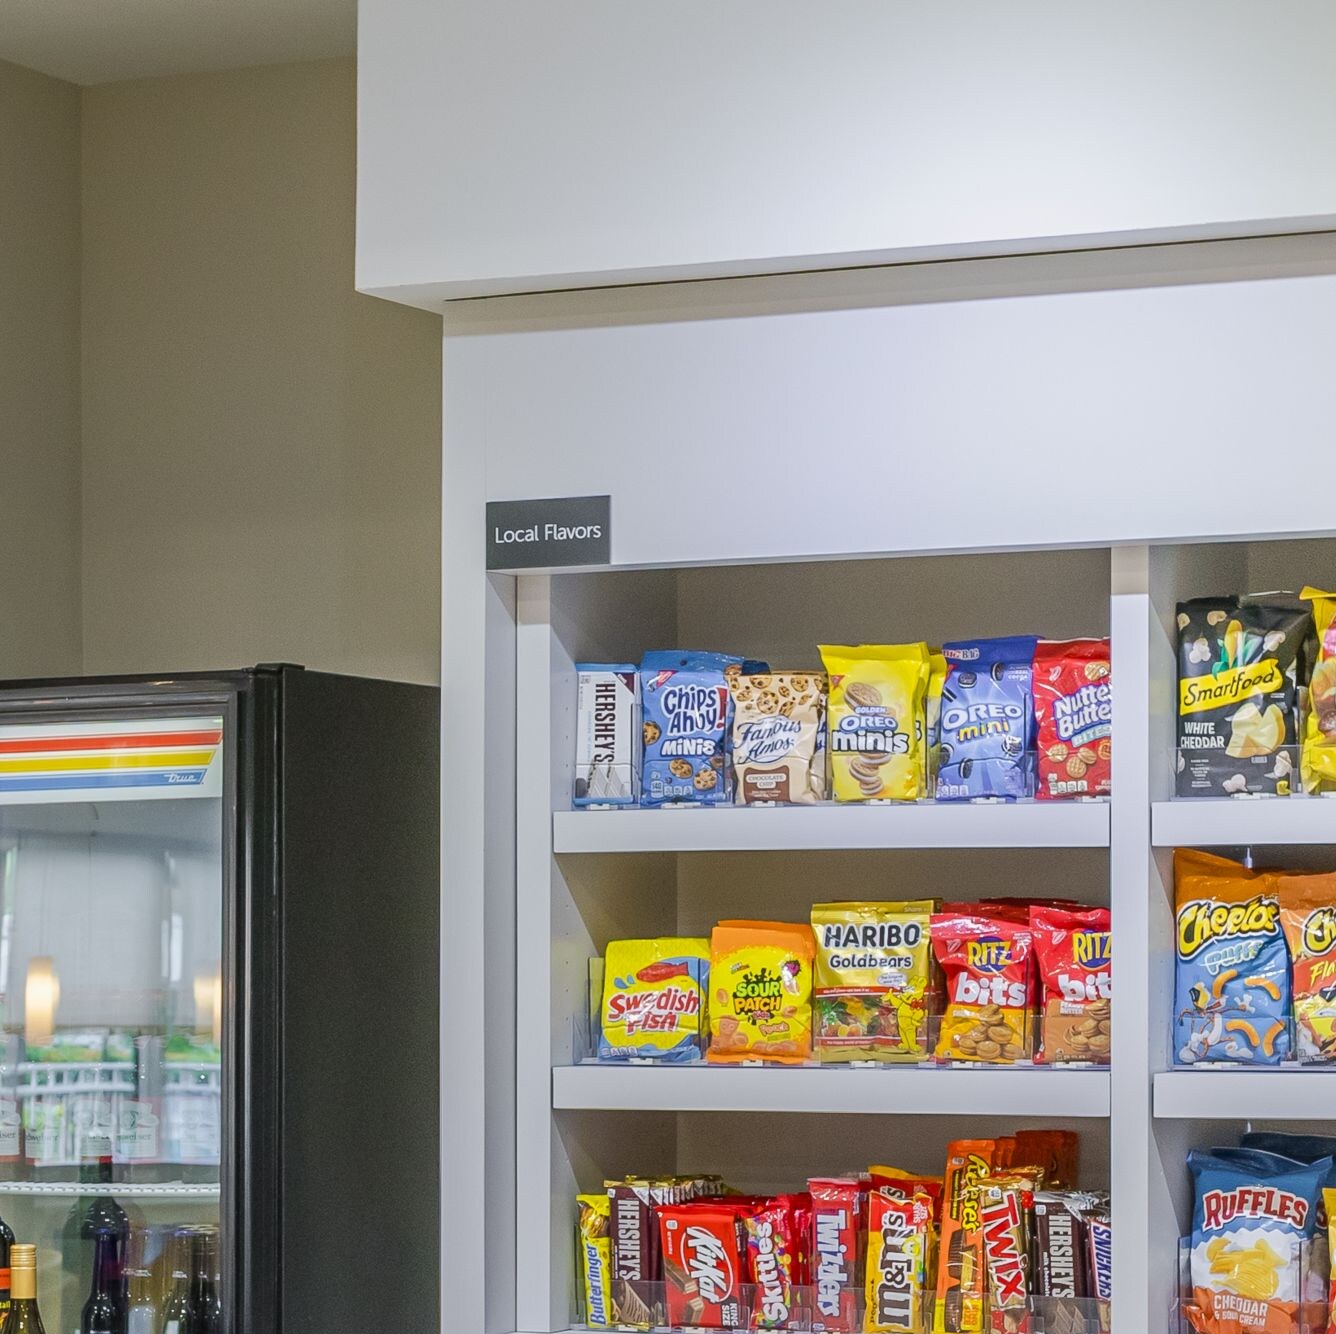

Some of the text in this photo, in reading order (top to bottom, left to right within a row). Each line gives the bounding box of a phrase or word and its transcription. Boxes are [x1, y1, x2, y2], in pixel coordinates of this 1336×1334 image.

[495, 523, 601, 543] Local Flavors
[1055, 684, 1112, 717] Nutte
[1184, 669, 1275, 706] Smartfood
[663, 686, 717, 717] Chips
[595, 683, 616, 763] HERSHEY'S
[840, 716, 897, 731] OREO
[943, 704, 1023, 730] OREO
[1184, 722, 1215, 735] WHITE
[732, 720, 802, 749] Famous
[832, 729, 910, 754] minis
[958, 719, 1011, 742] mini
[1181, 736, 1225, 748] CHEDDAR
[737, 737, 792, 764] Amos
[824, 924, 921, 948] HARIBO
[1178, 899, 1279, 956] Cheetos
[830, 954, 911, 969] Goldbears
[967, 941, 1011, 966] RITZ
[736, 981, 780, 997] SOUR
[955, 972, 1027, 1007] bits
[608, 987, 699, 1019] Swedish
[735, 997, 780, 1013] PATCH
[626, 1011, 677, 1034] Fish
[1203, 1188, 1308, 1229] RUFFLES
[618, 1200, 641, 1280] HERSHEY'S
[983, 1192, 1025, 1304] TWIX
[1049, 1215, 1075, 1298] HERSHEY'S
[1093, 1225, 1112, 1299] SNICKERS
[586, 1243, 606, 1325] Butterfinger
[756, 1222, 788, 1321] Skittles
[722, 1304, 731, 1326] SIZE
[730, 1302, 739, 1326] KING
[1214, 1295, 1268, 1317] CHEDDAR
[1239, 1313, 1266, 1327] CREAM
